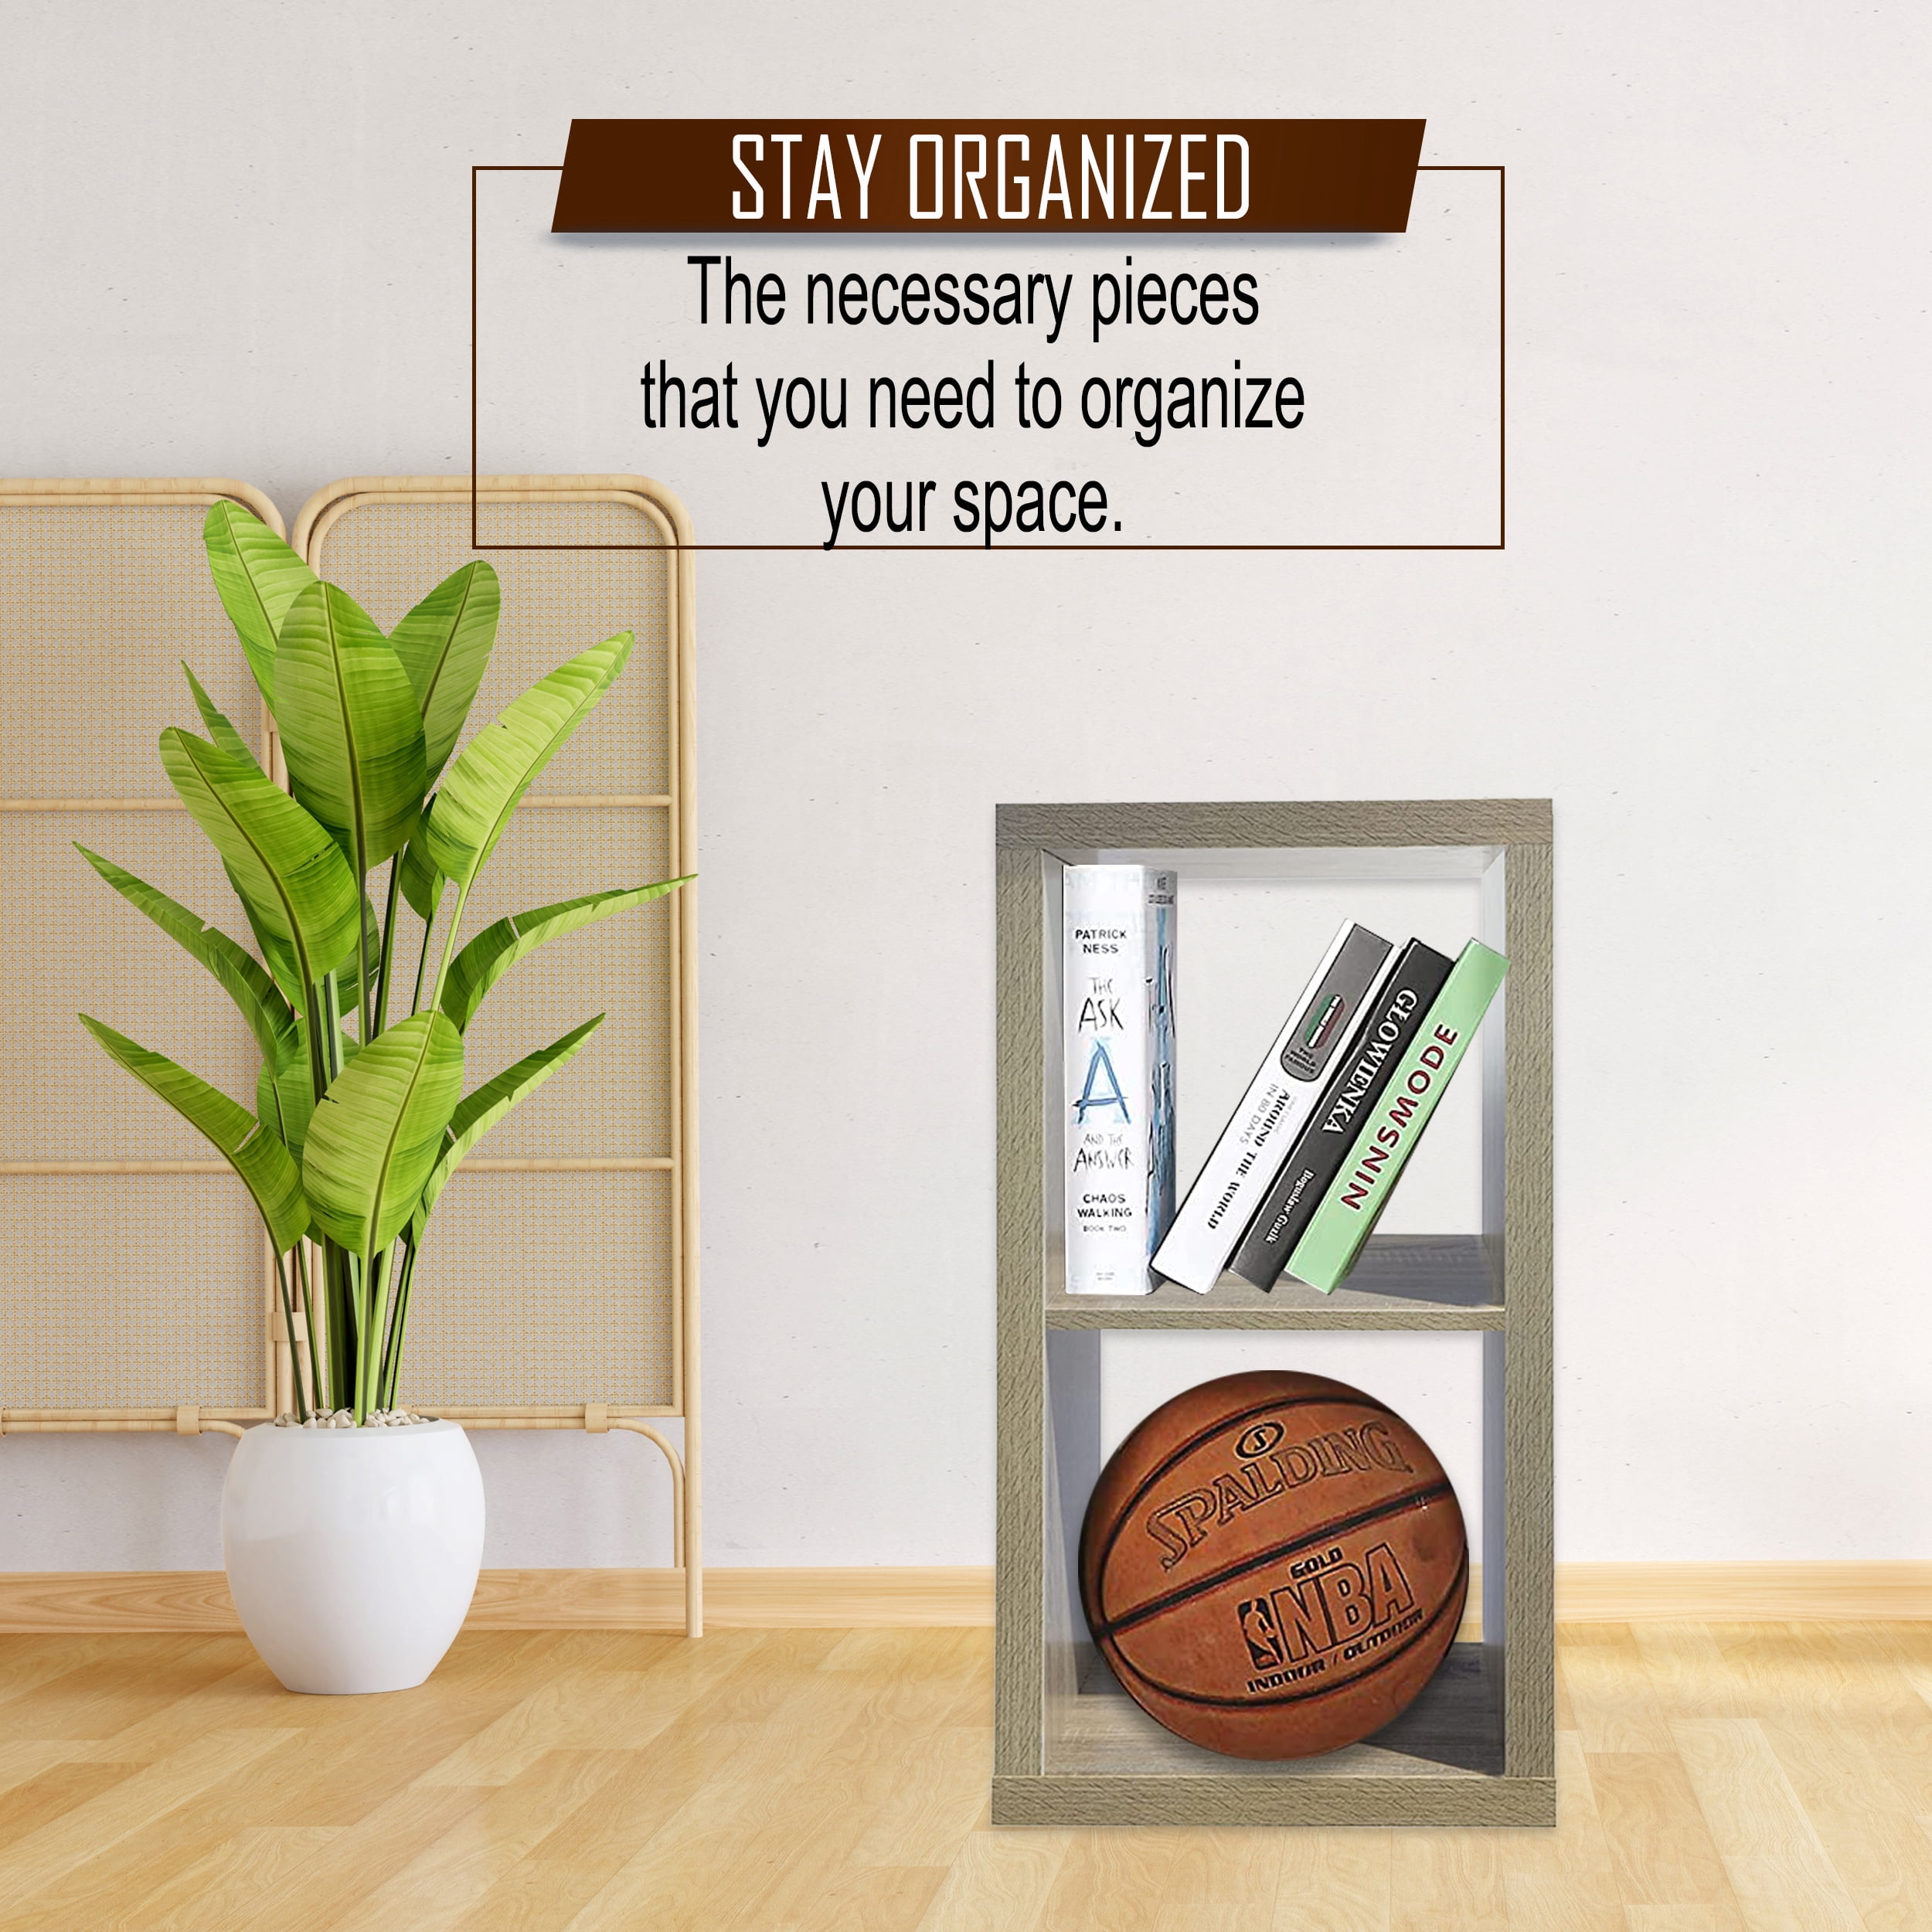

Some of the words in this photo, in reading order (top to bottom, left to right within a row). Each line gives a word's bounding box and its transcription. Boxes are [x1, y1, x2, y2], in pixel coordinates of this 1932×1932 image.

[1075, 929, 1127, 940] PATRICK
[1083, 944, 1119, 954] NESS
[1077, 997, 1124, 1033] ASK
[1267, 1083, 1279, 1099] IN
[1253, 1088, 1291, 1147] AROUND
[1257, 1097, 1271, 1114] 80
[1340, 1023, 1458, 1210] NINSMODE
[1083, 1133, 1104, 1145] AND
[1239, 1114, 1262, 1145] DAYS
[1073, 1147, 1134, 1172] ANSWER
[1236, 1151, 1258, 1179] THE
[1077, 1207, 1133, 1218] WALKING
[1083, 1193, 1126, 1204] CHAOS
[1207, 1182, 1240, 1230] WORLD
[1083, 1224, 1104, 1233] BOOK
[1108, 1224, 1127, 1233] TWO
[1145, 1420, 1414, 1573] SPALDING
[1290, 1547, 1344, 1579] GOLD
[1270, 1542, 1415, 1662] NBA
[1247, 1658, 1326, 1692] INDOOR
[1342, 1607, 1423, 1661] OUTDOOR
